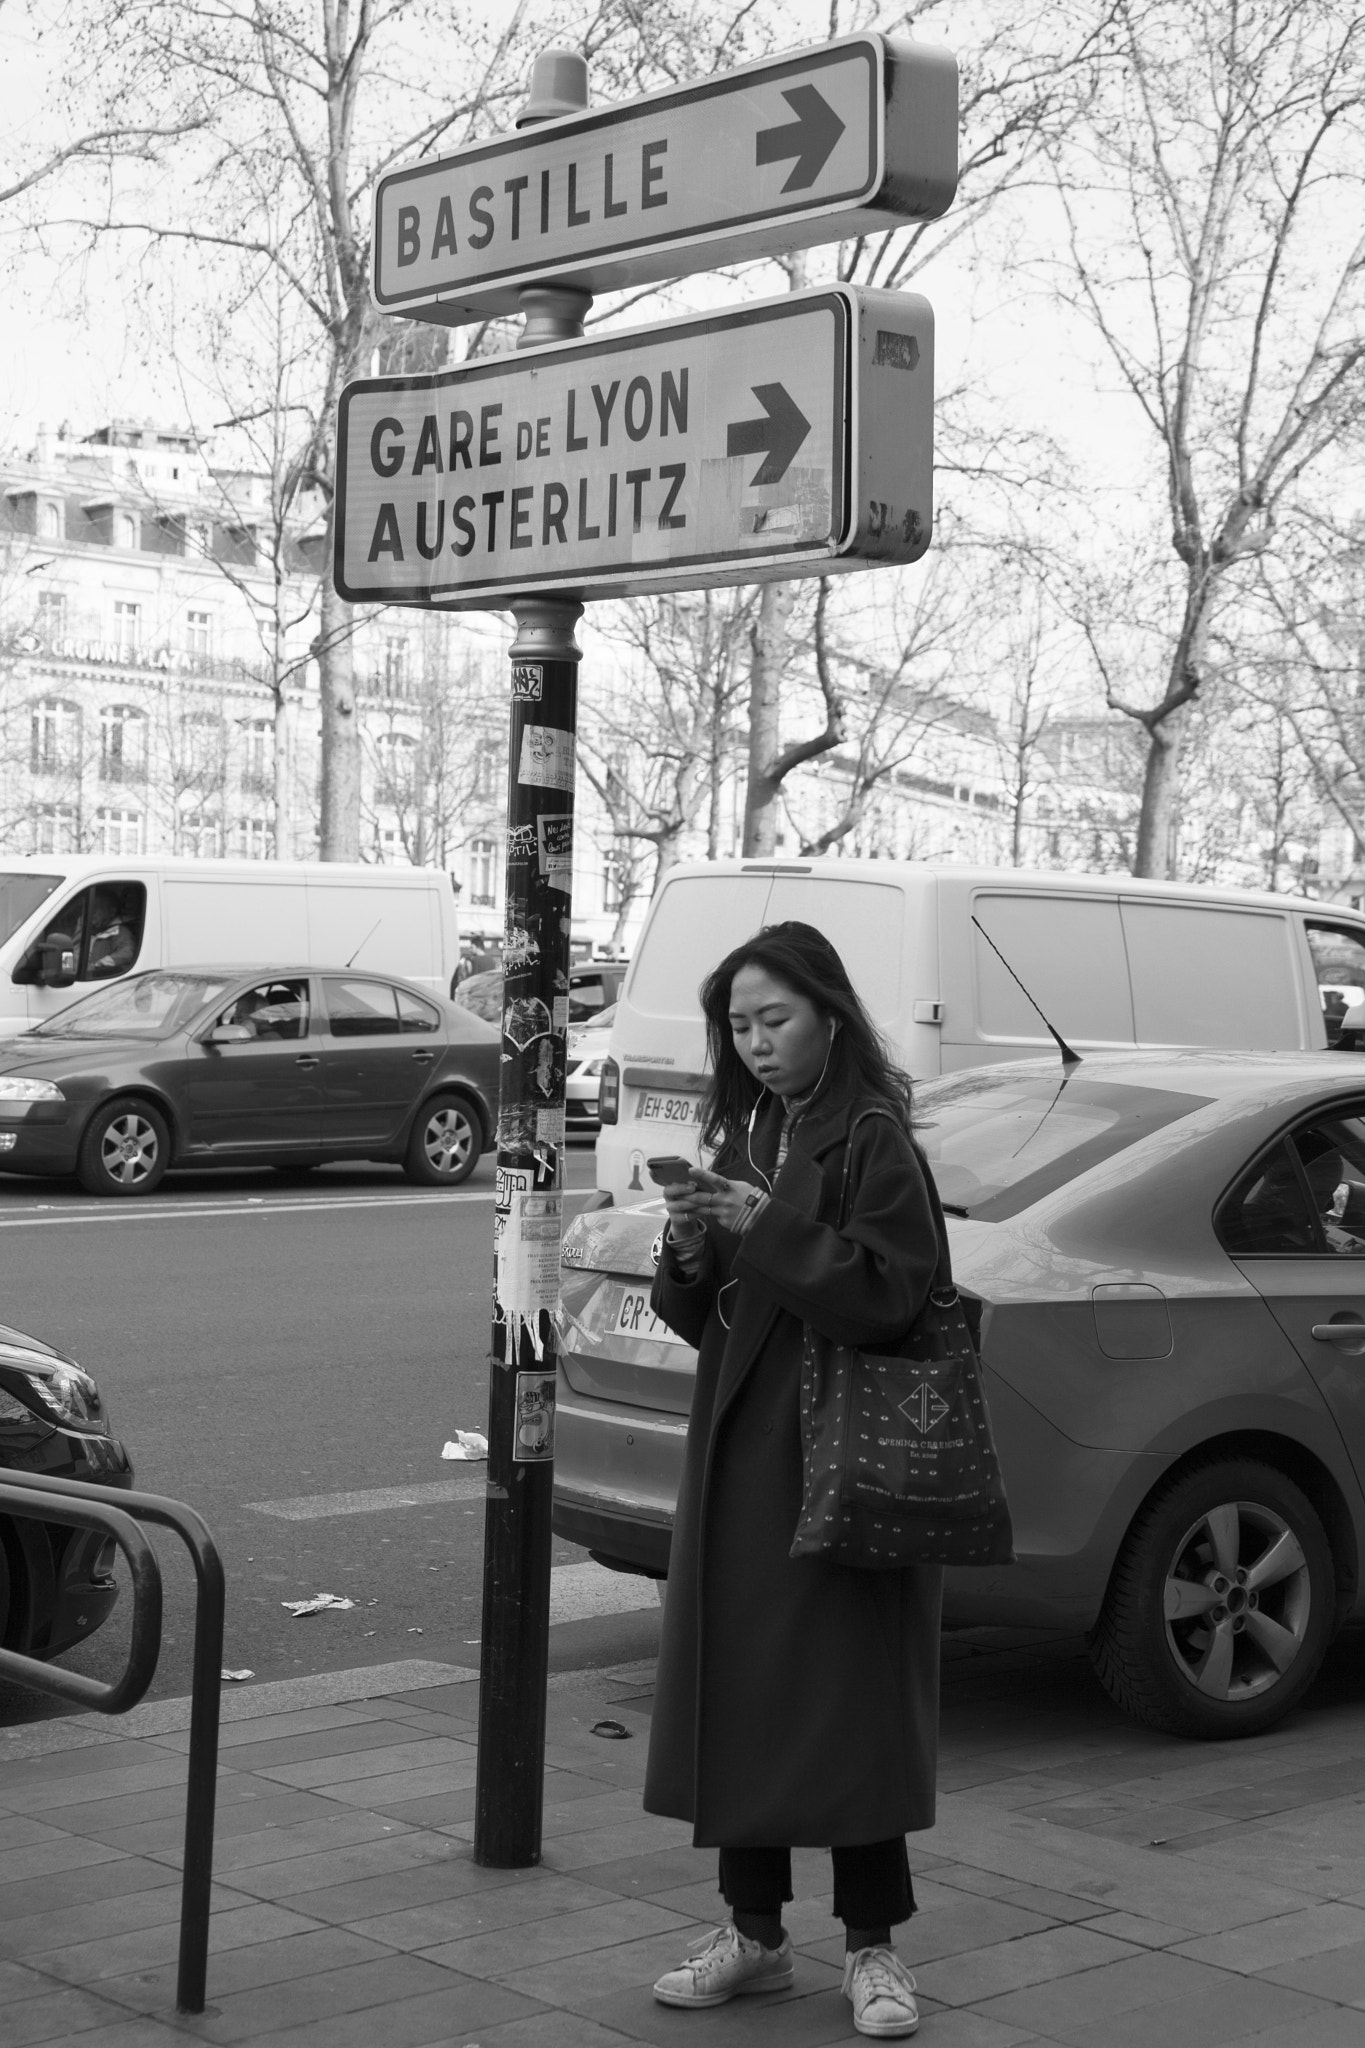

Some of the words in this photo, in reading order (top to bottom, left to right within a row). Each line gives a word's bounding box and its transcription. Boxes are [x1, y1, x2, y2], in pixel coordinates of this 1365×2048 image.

[397, 138, 668, 268] BASTILLE
[369, 403, 504, 478] GARE
[516, 416, 552, 461] DE
[566, 367, 690, 453] LYON
[367, 462, 688, 563] AUSTERLITZ
[52, 638, 130, 664] CROWNE
[136, 646, 194, 671] PLAZA
[623, 1054, 675, 1066] TRANSPORTER
[644, 1096, 707, 1123] EH-920-N
[878, 1437, 917, 1449] OPENING
